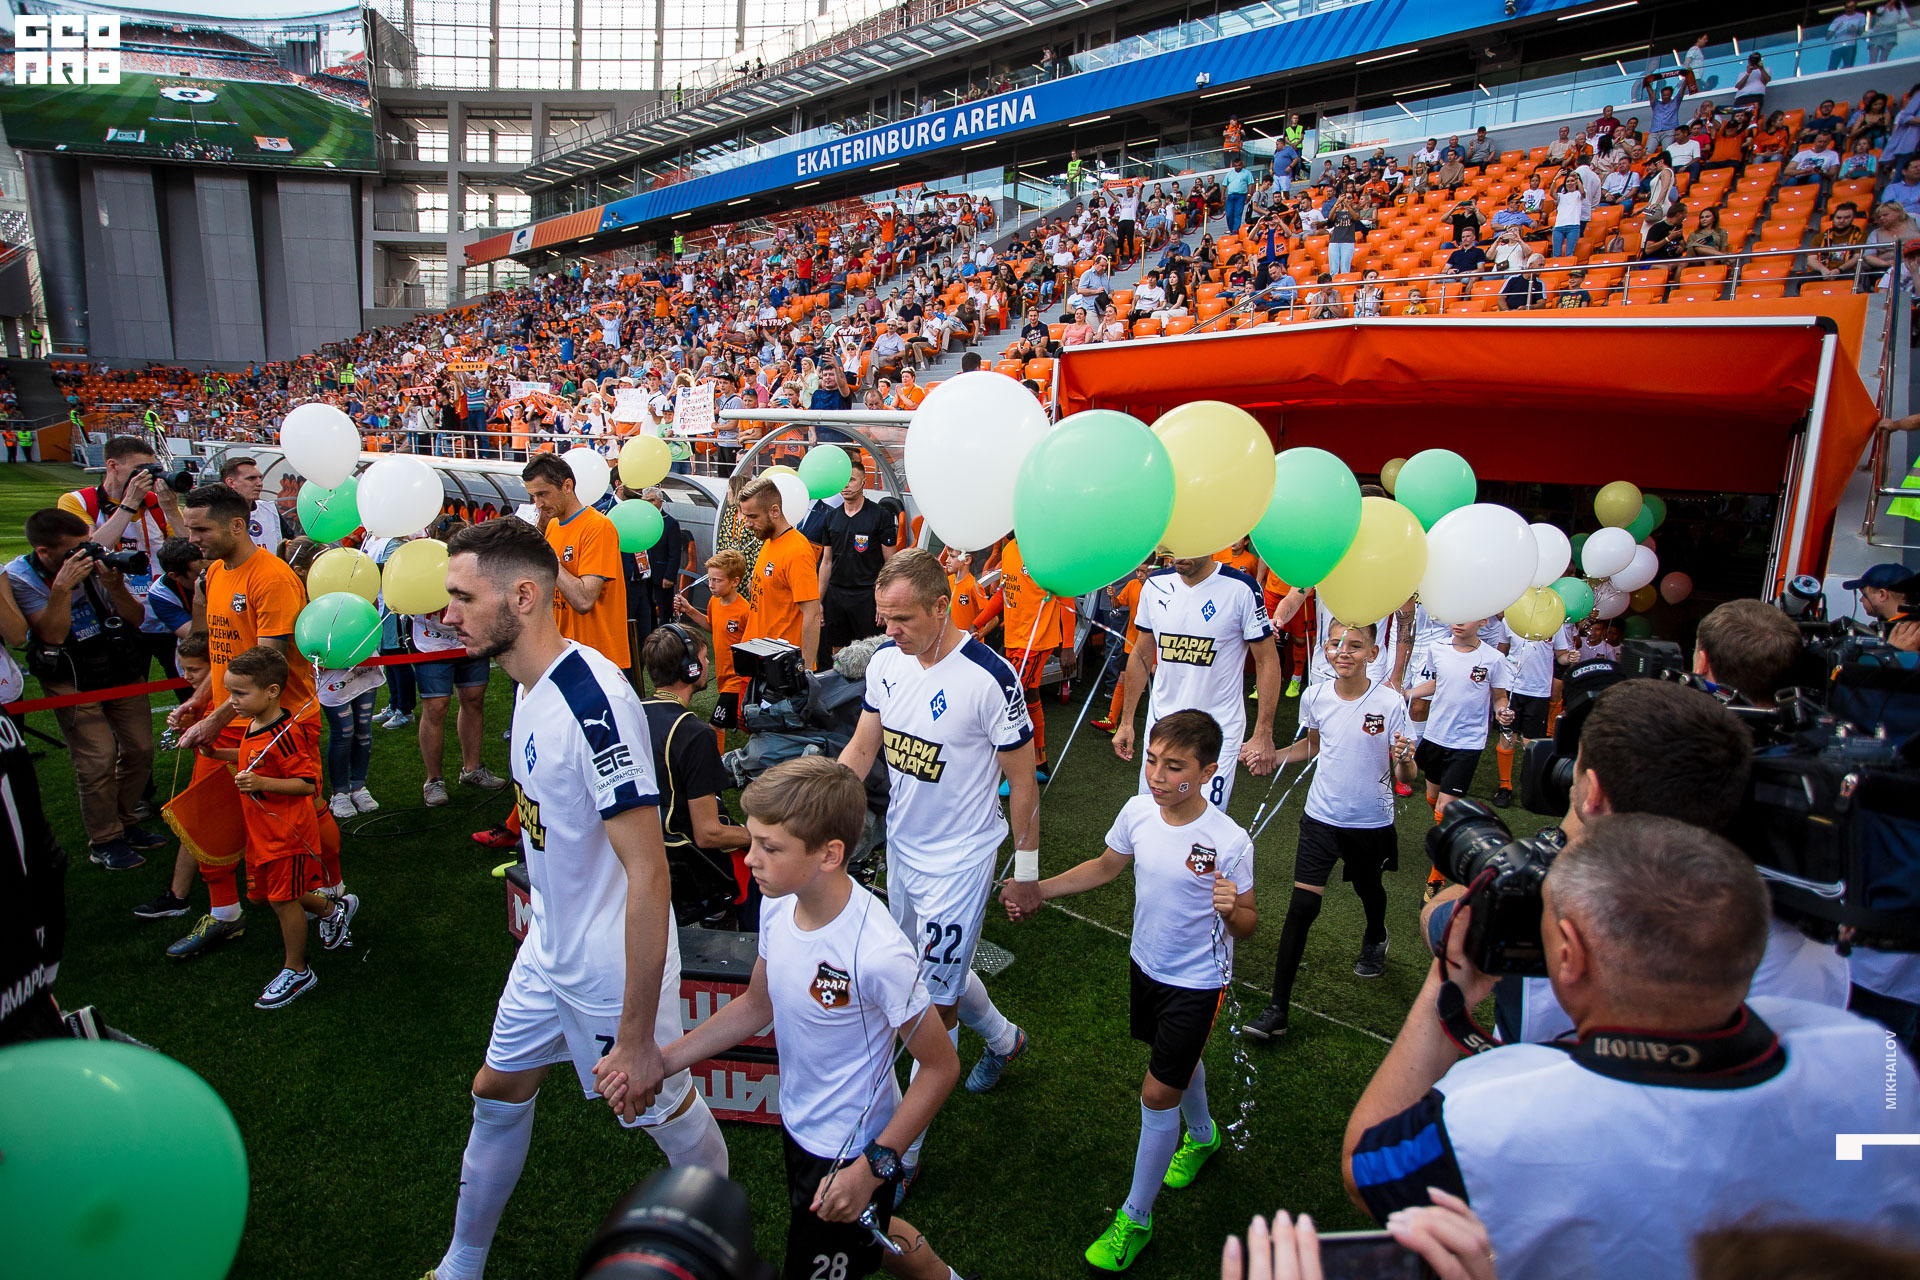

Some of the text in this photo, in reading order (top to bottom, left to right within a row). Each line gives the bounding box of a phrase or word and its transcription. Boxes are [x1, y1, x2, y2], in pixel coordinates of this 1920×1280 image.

[796, 94, 1037, 177] EKATERINBURG ARENA
[209, 627, 243, 642] ЖДЕНИЯ,
[1160, 634, 1212, 652] ПАРИ
[1162, 647, 1214, 665] МАТЧ
[714, 706, 726, 721] 84
[882, 728, 938, 763] ПАРИ
[885, 747, 941, 781] МАТЧ
[1209, 775, 1225, 807] 8
[1190, 854, 1215, 862] УРАЛ
[924, 921, 963, 965] 22
[816, 978, 848, 990] УРАЛ
[594, 1033, 616, 1058] 7
[1594, 1036, 1702, 1069] Canon
[809, 1251, 849, 1280] 28
